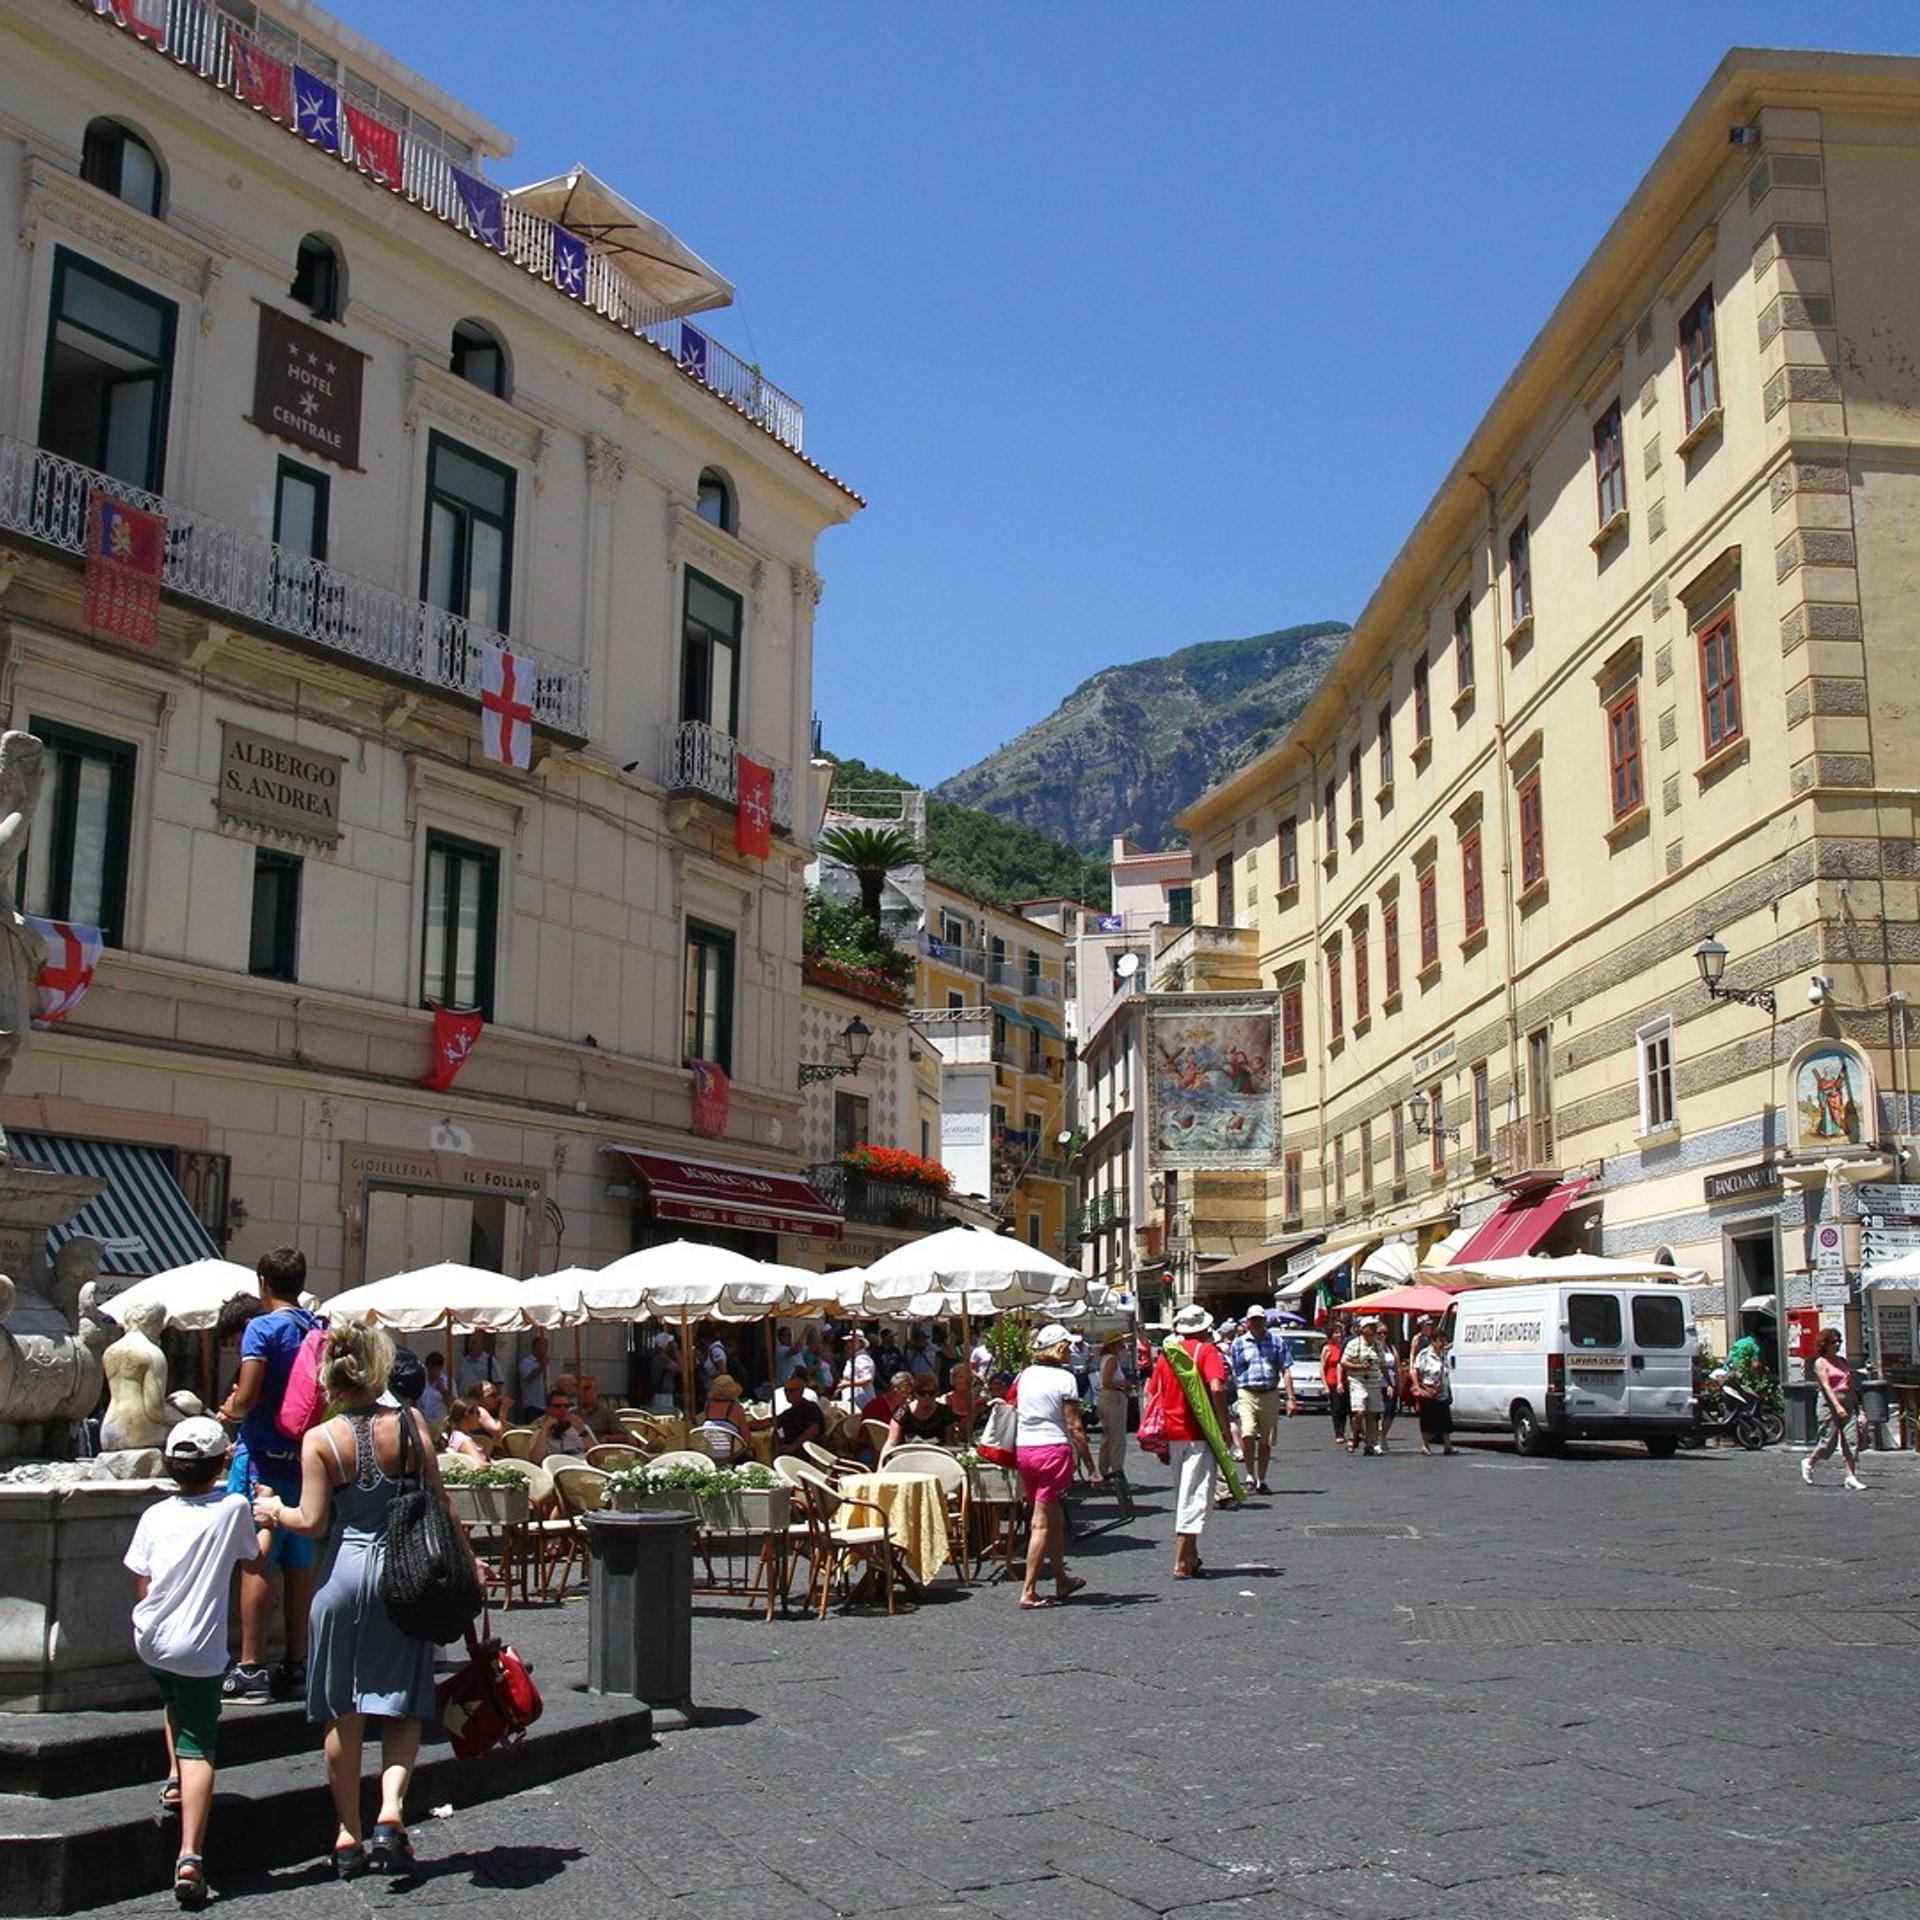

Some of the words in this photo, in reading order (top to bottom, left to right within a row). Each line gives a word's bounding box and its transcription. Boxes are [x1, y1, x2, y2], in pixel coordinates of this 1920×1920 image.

[287, 363, 332, 396] HOTEL
[273, 405, 342, 449] CENTRALE
[229, 740, 335, 787] ALBERGO
[463, 1171, 475, 1183] IL
[485, 1172, 541, 1190] FOLLARO
[1495, 1322, 1541, 1344] LAVANDERIA
